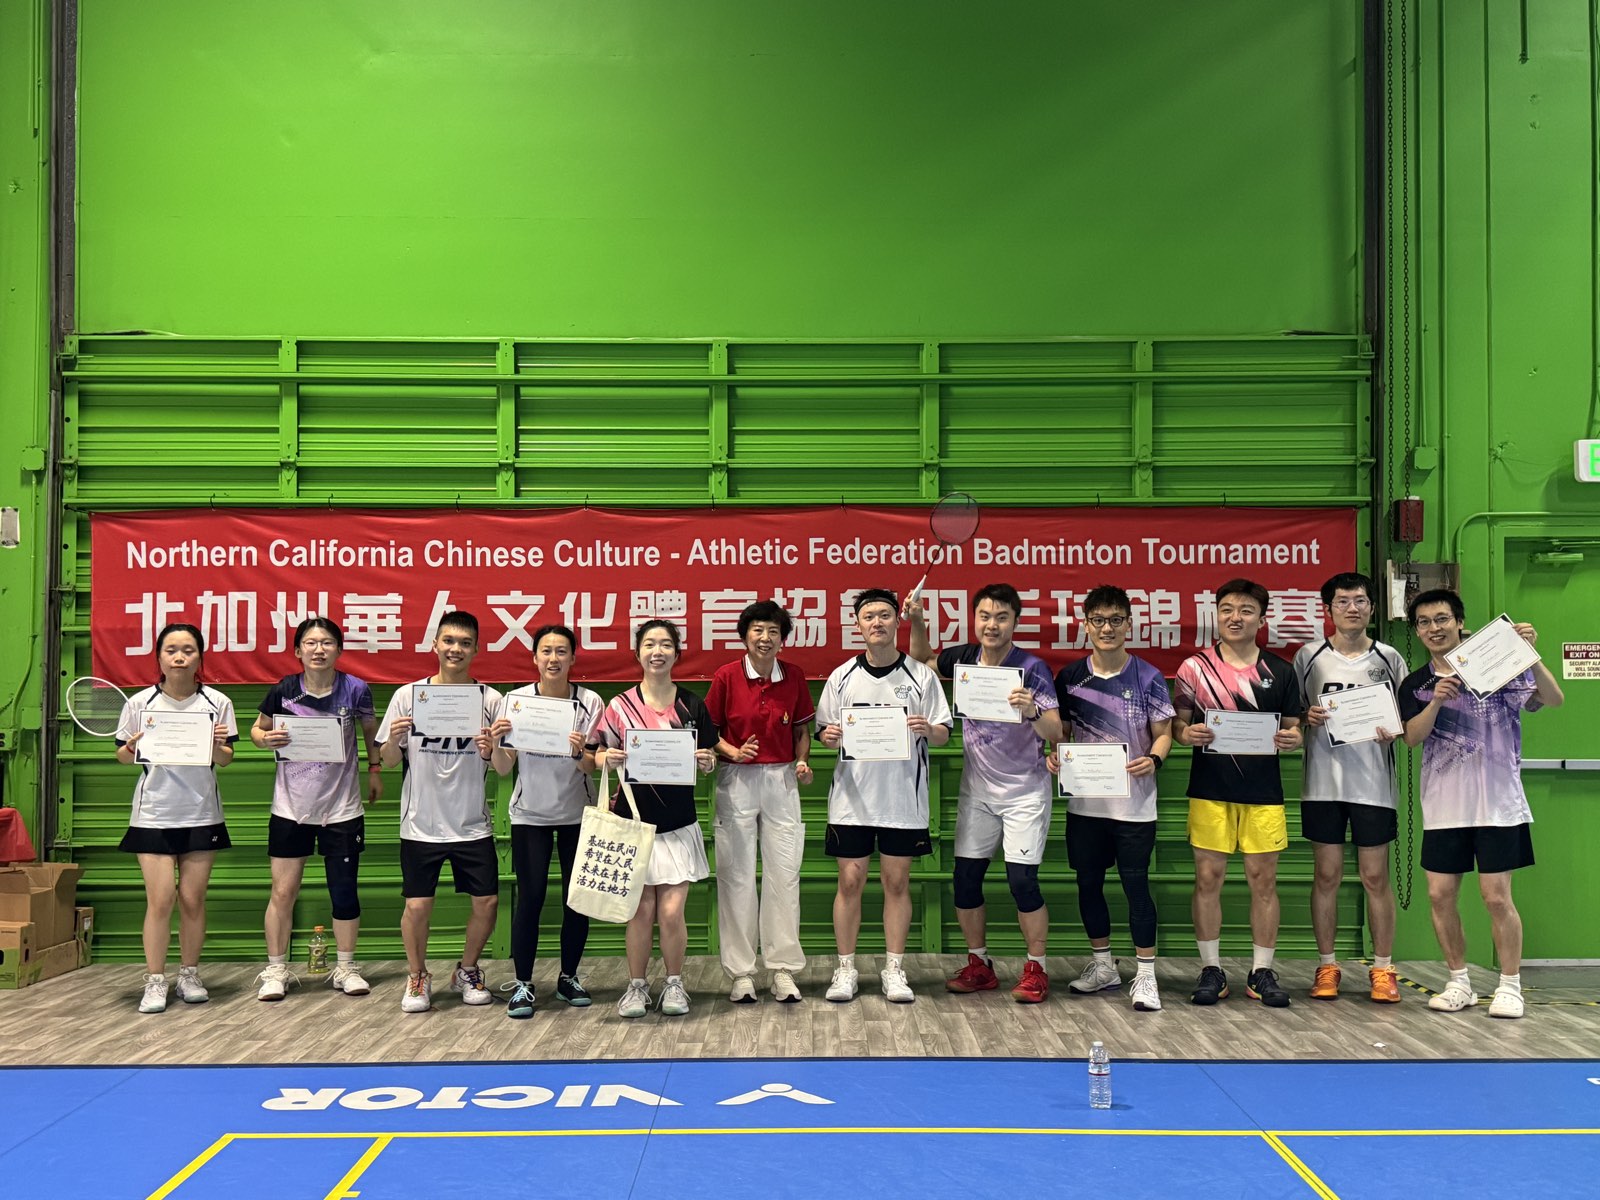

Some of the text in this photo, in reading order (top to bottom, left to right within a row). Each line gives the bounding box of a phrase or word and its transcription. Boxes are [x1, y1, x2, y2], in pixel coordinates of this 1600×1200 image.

[126, 540, 258, 569] Northern
[268, 539, 414, 568] California
[423, 539, 544, 567] Chinese
[553, 539, 661, 567] Culture
[686, 538, 799, 566] Athletic
[808, 537, 963, 565] Federation
[973, 538, 1132, 565] Badminton
[1141, 537, 1320, 565] Tournament
[587, 834, 638, 858] 基础在民间
[584, 847, 634, 872] 希望在人民
[581, 861, 631, 884] 未来在青年
[576, 874, 630, 897] 活力在地方
[261, 1084, 684, 1111] VICTOR
